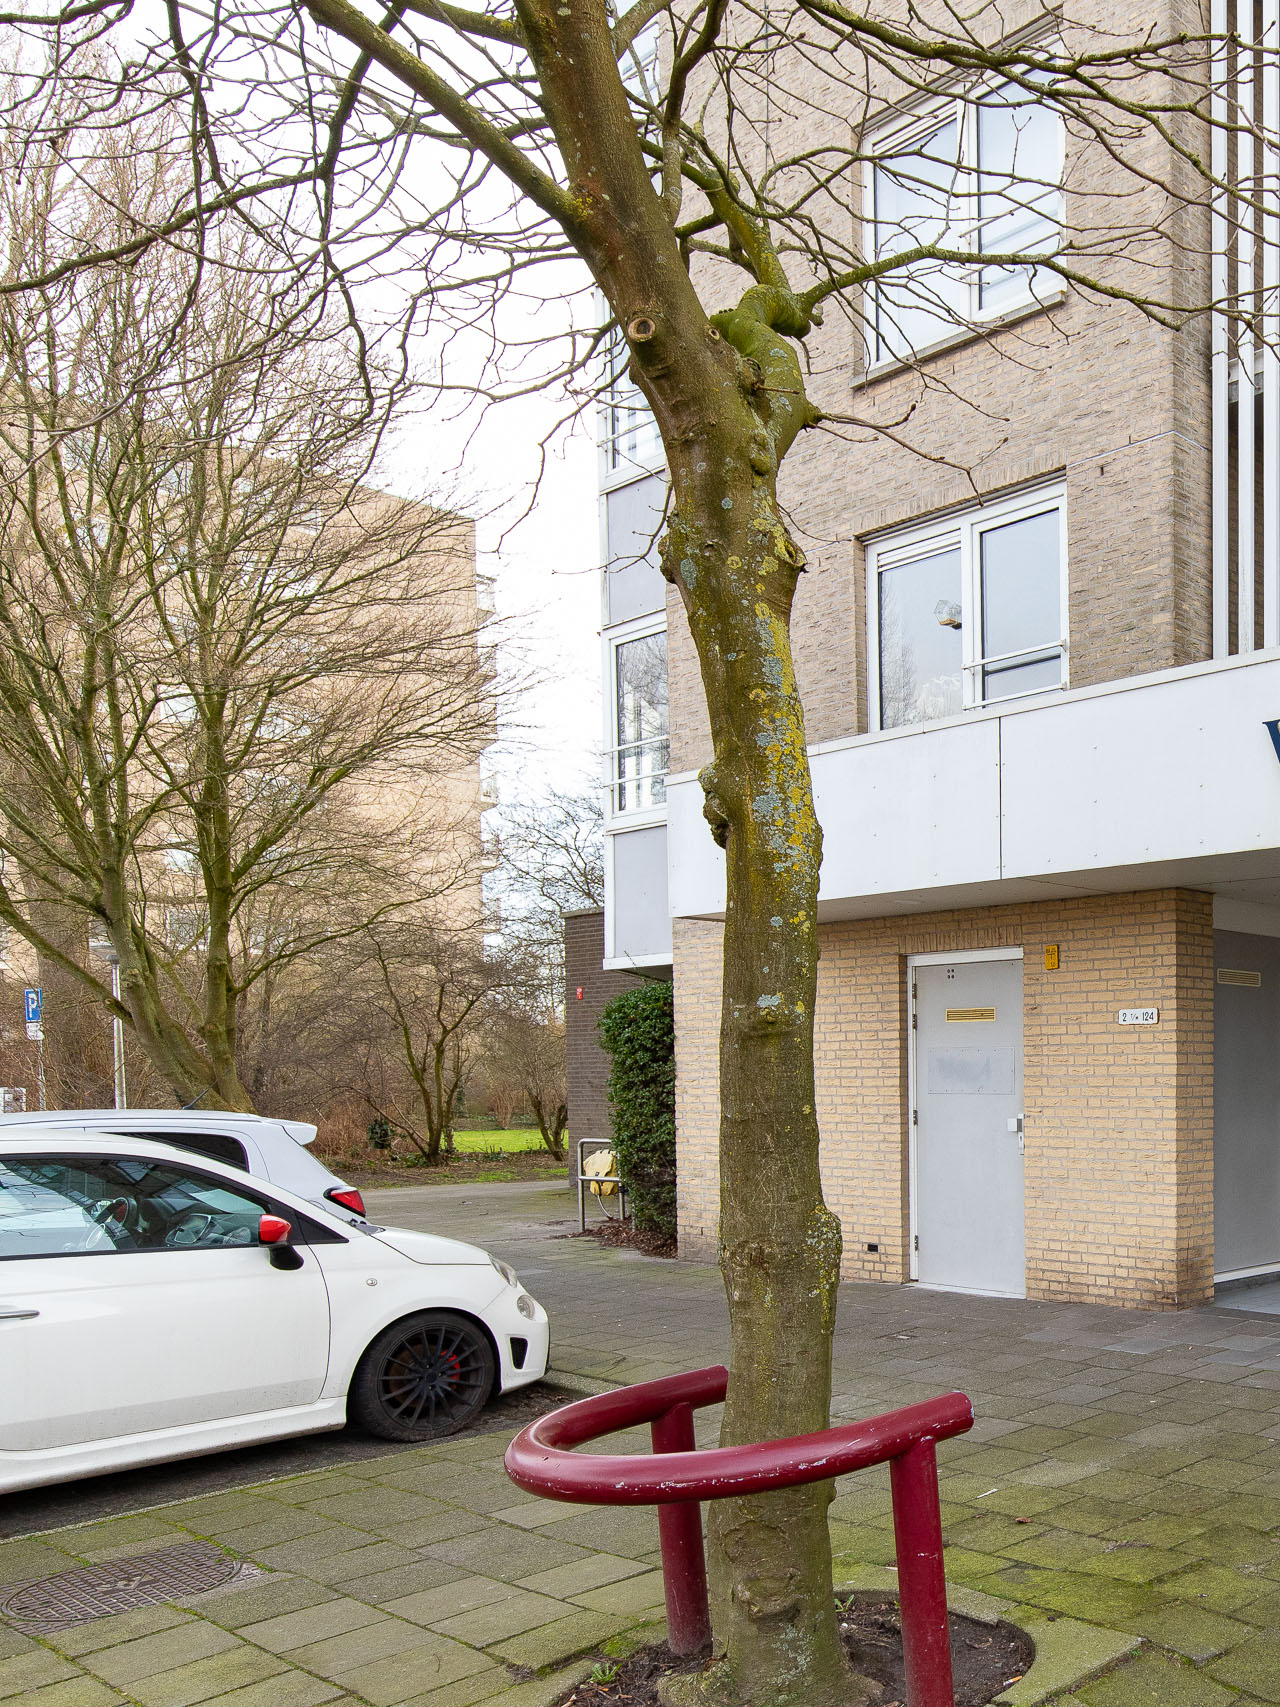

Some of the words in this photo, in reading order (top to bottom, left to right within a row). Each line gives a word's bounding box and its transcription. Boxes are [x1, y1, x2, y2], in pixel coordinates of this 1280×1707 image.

[28, 993, 38, 1018] P
[1122, 1012, 1127, 1022] 2
[1142, 1011, 1154, 1022] 124
